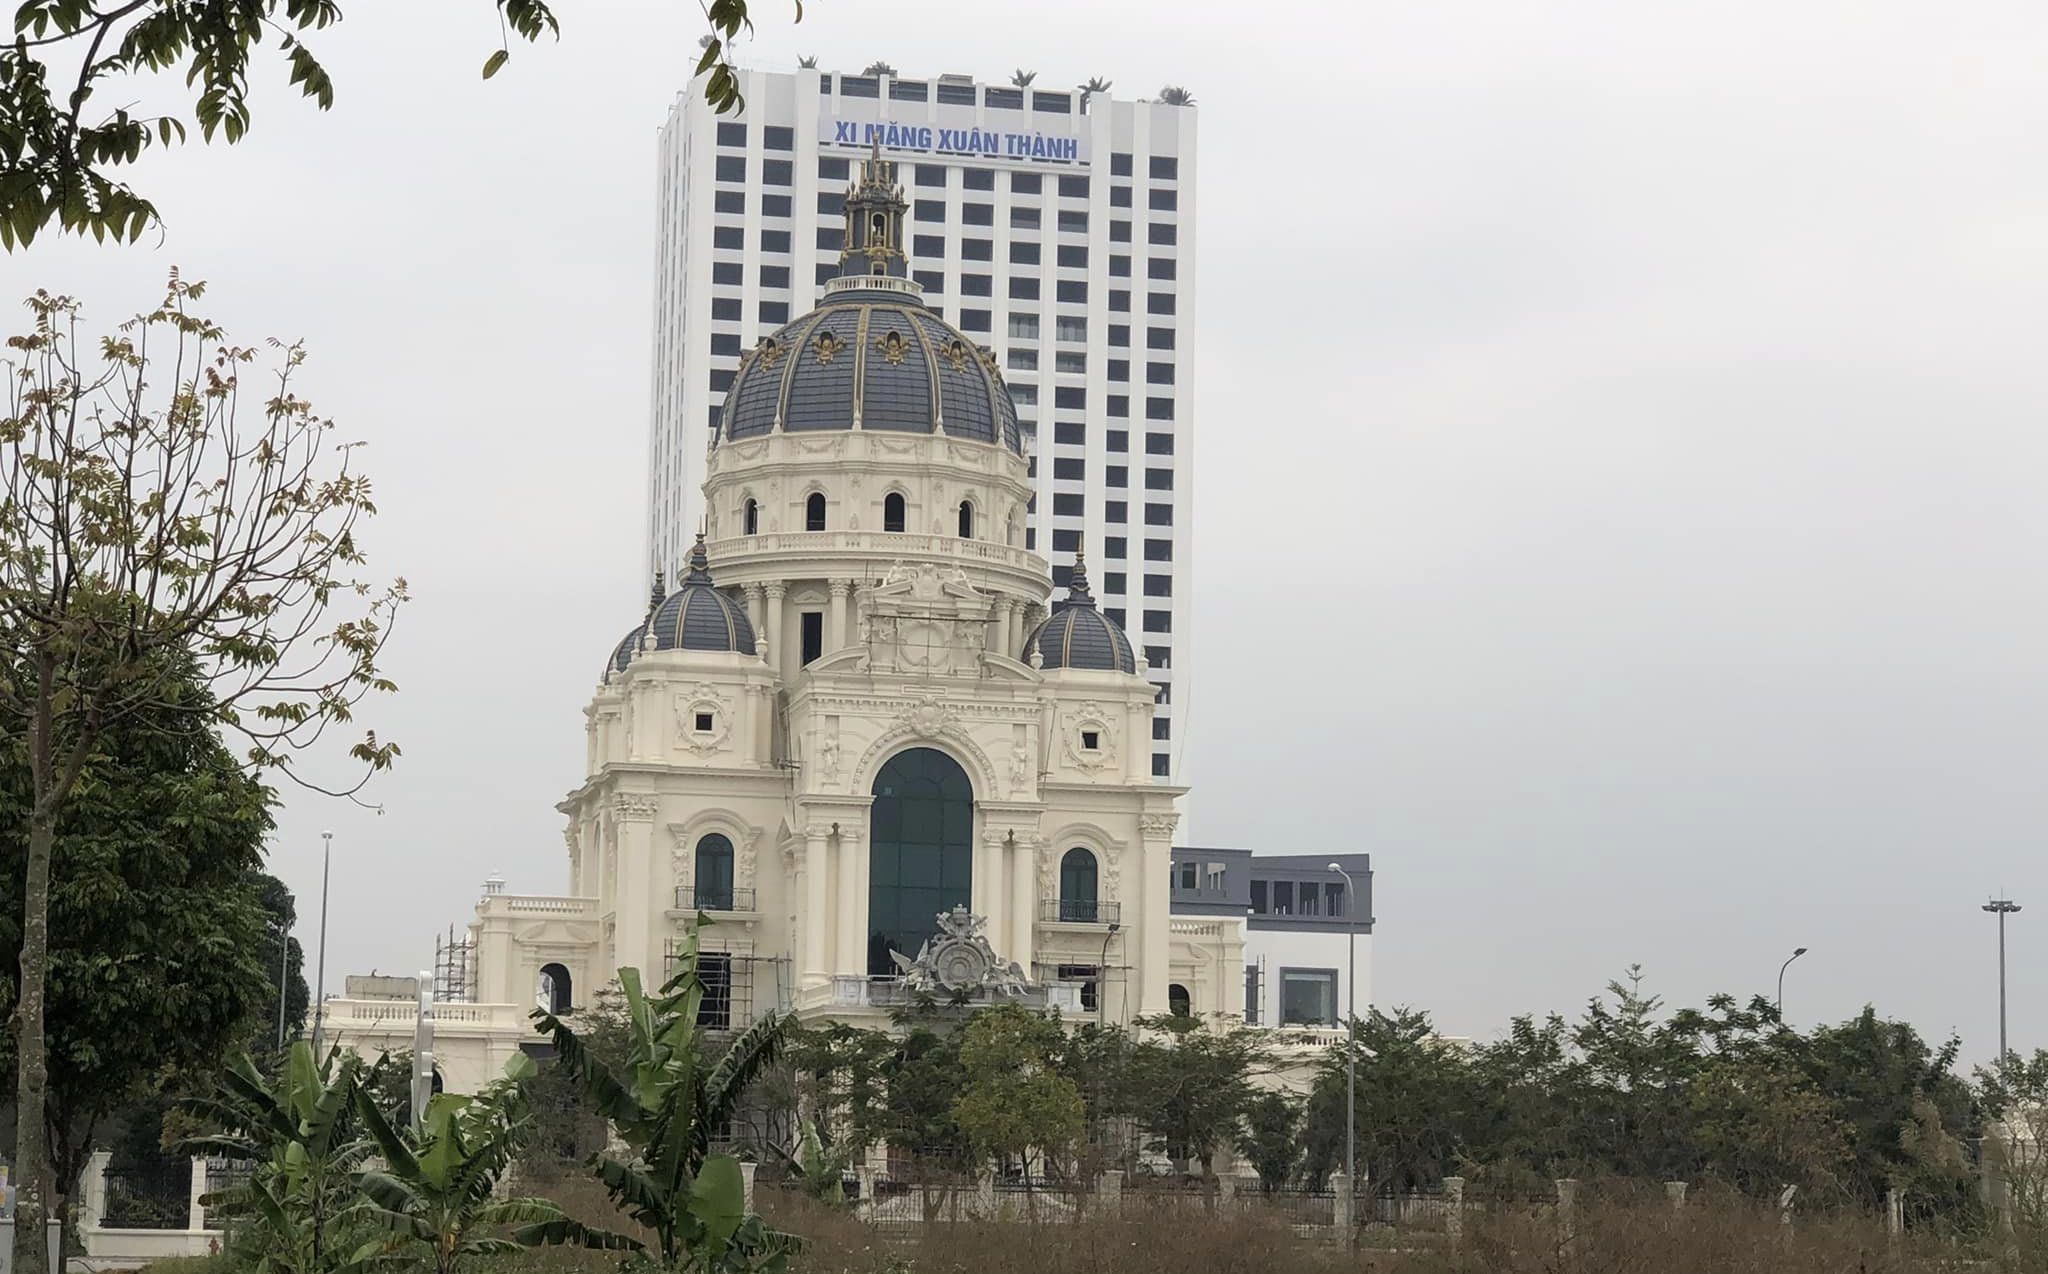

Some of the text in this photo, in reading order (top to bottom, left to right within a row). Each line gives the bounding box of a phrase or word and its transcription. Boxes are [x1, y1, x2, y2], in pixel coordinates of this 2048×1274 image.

[835, 121, 1077, 159] XI MĂNG XUÂN THÀNH
